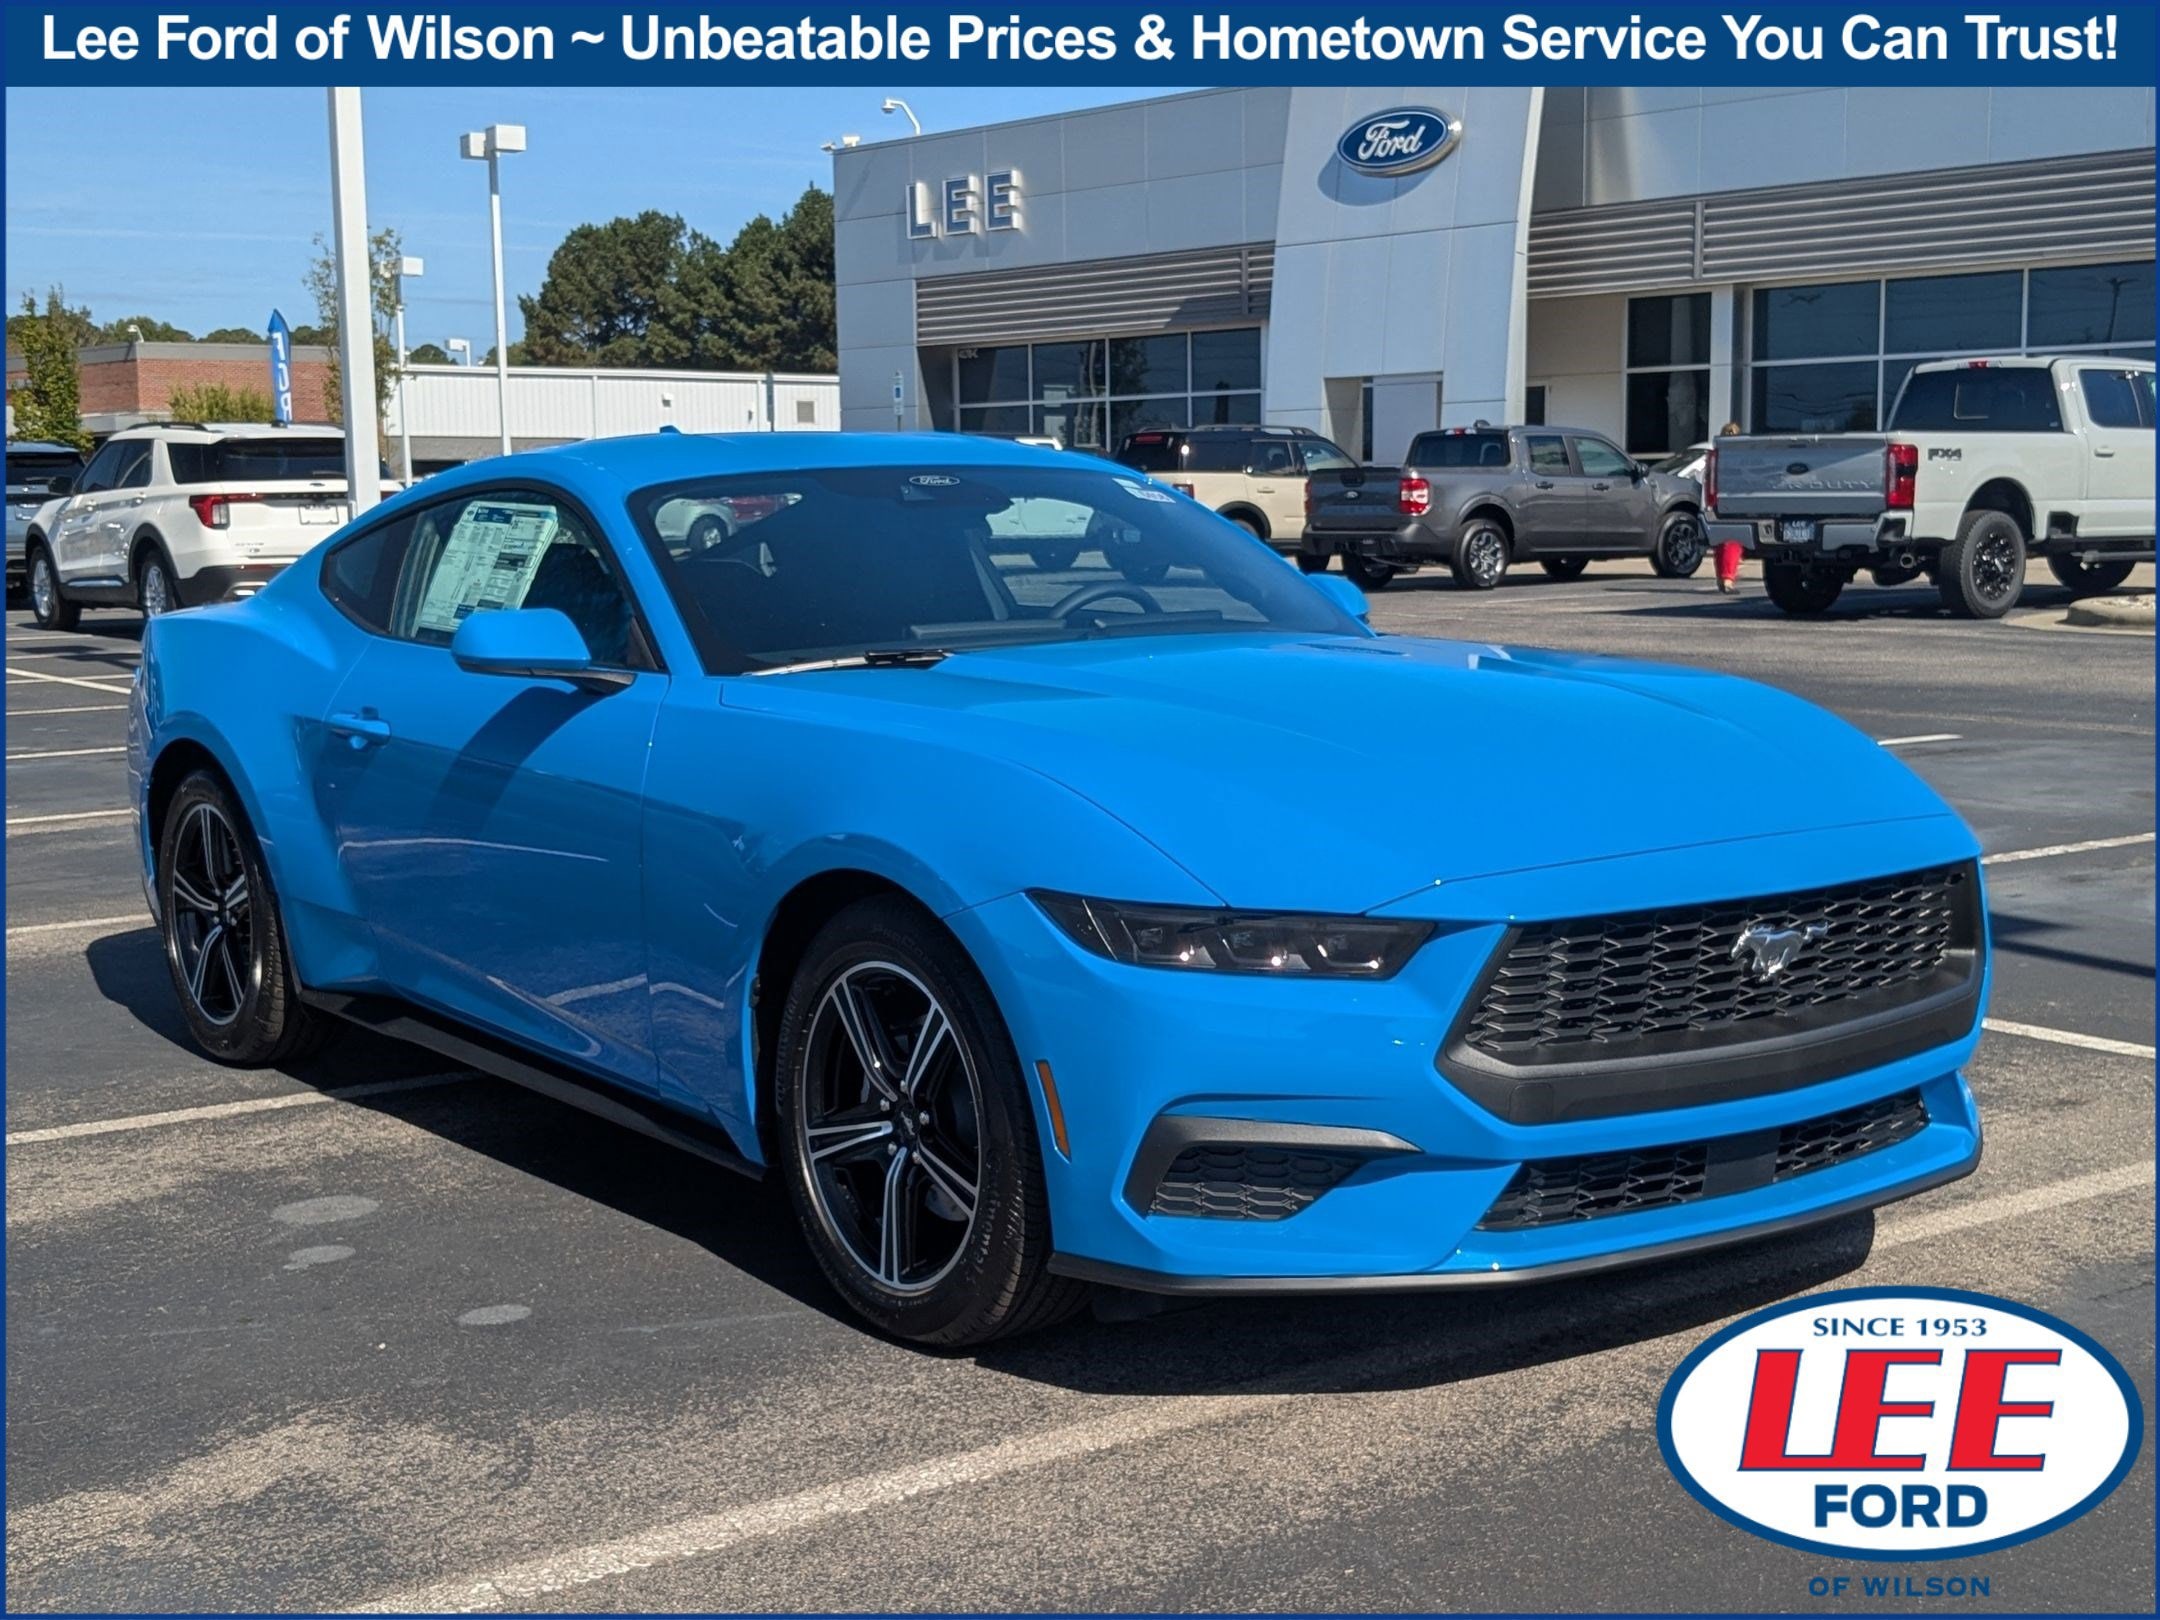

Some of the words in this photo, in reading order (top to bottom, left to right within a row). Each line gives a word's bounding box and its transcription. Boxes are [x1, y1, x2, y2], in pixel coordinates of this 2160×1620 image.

[1357, 119, 1426, 160] Ford
[905, 168, 1021, 240] LEE
[1927, 448, 1962, 461] FX4
